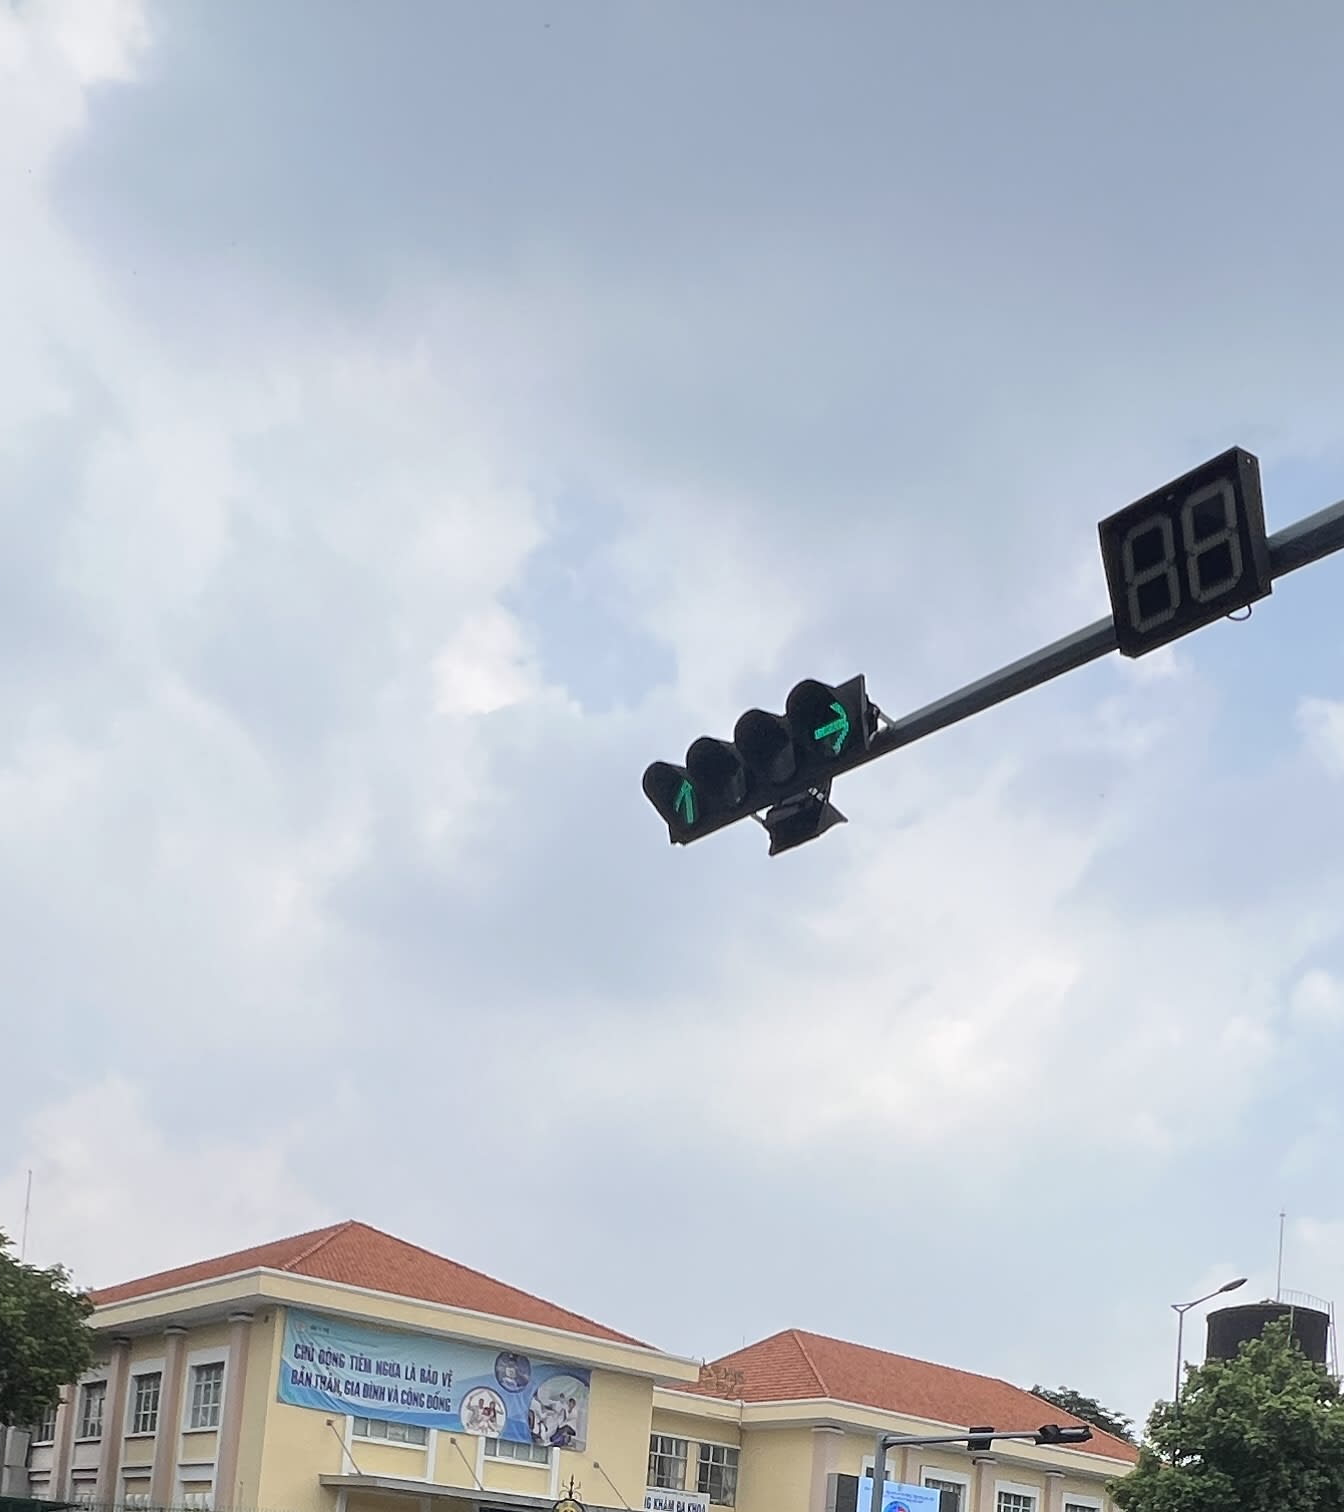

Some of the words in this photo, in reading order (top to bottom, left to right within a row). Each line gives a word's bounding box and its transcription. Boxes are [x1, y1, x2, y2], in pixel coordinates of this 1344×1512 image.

[293, 1342, 315, 1362] CHỦ
[318, 1346, 346, 1370] ĐỘNG
[404, 1363, 416, 1382] LÀ
[419, 1364, 439, 1385] BẢO
[344, 1380, 361, 1397] GIA
[387, 1384, 399, 1403] VÀ
